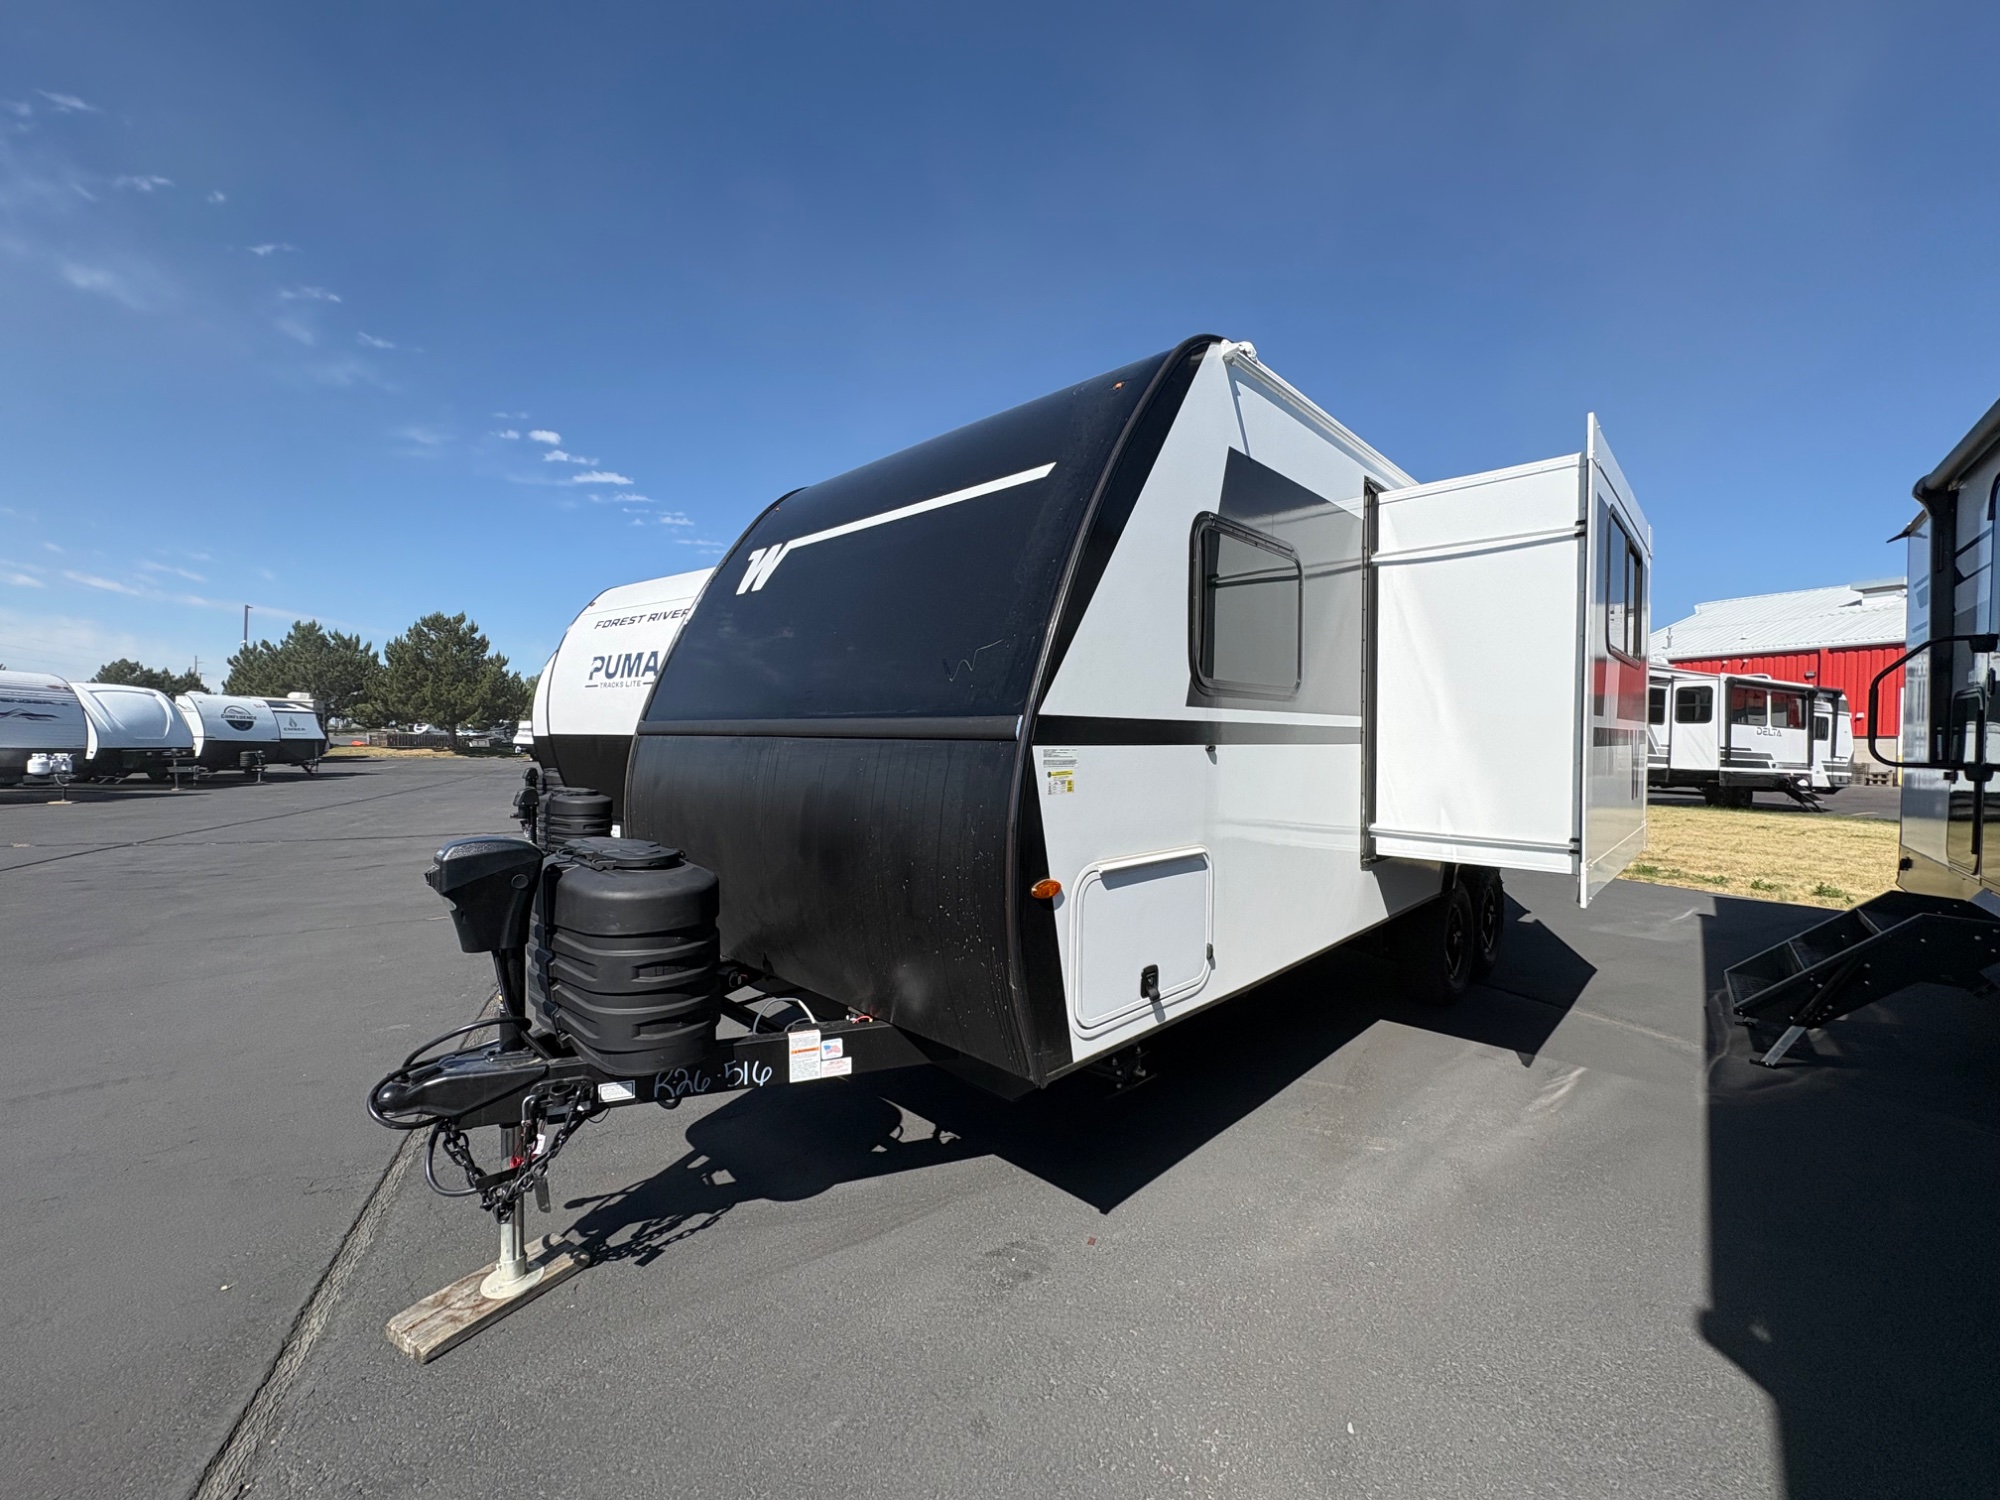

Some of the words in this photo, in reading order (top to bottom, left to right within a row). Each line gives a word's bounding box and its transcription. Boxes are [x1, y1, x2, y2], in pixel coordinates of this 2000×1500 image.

[594, 614, 647, 630] FOREST
[648, 608, 690, 623] RIVER
[588, 650, 660, 681] PUMA
[600, 681, 624, 689] TRACKS
[625, 680, 642, 688] LITE
[221, 713, 257, 721] CONFLUENCE
[1756, 727, 1782, 737] DELTA
[723, 1060, 773, 1087] 516
